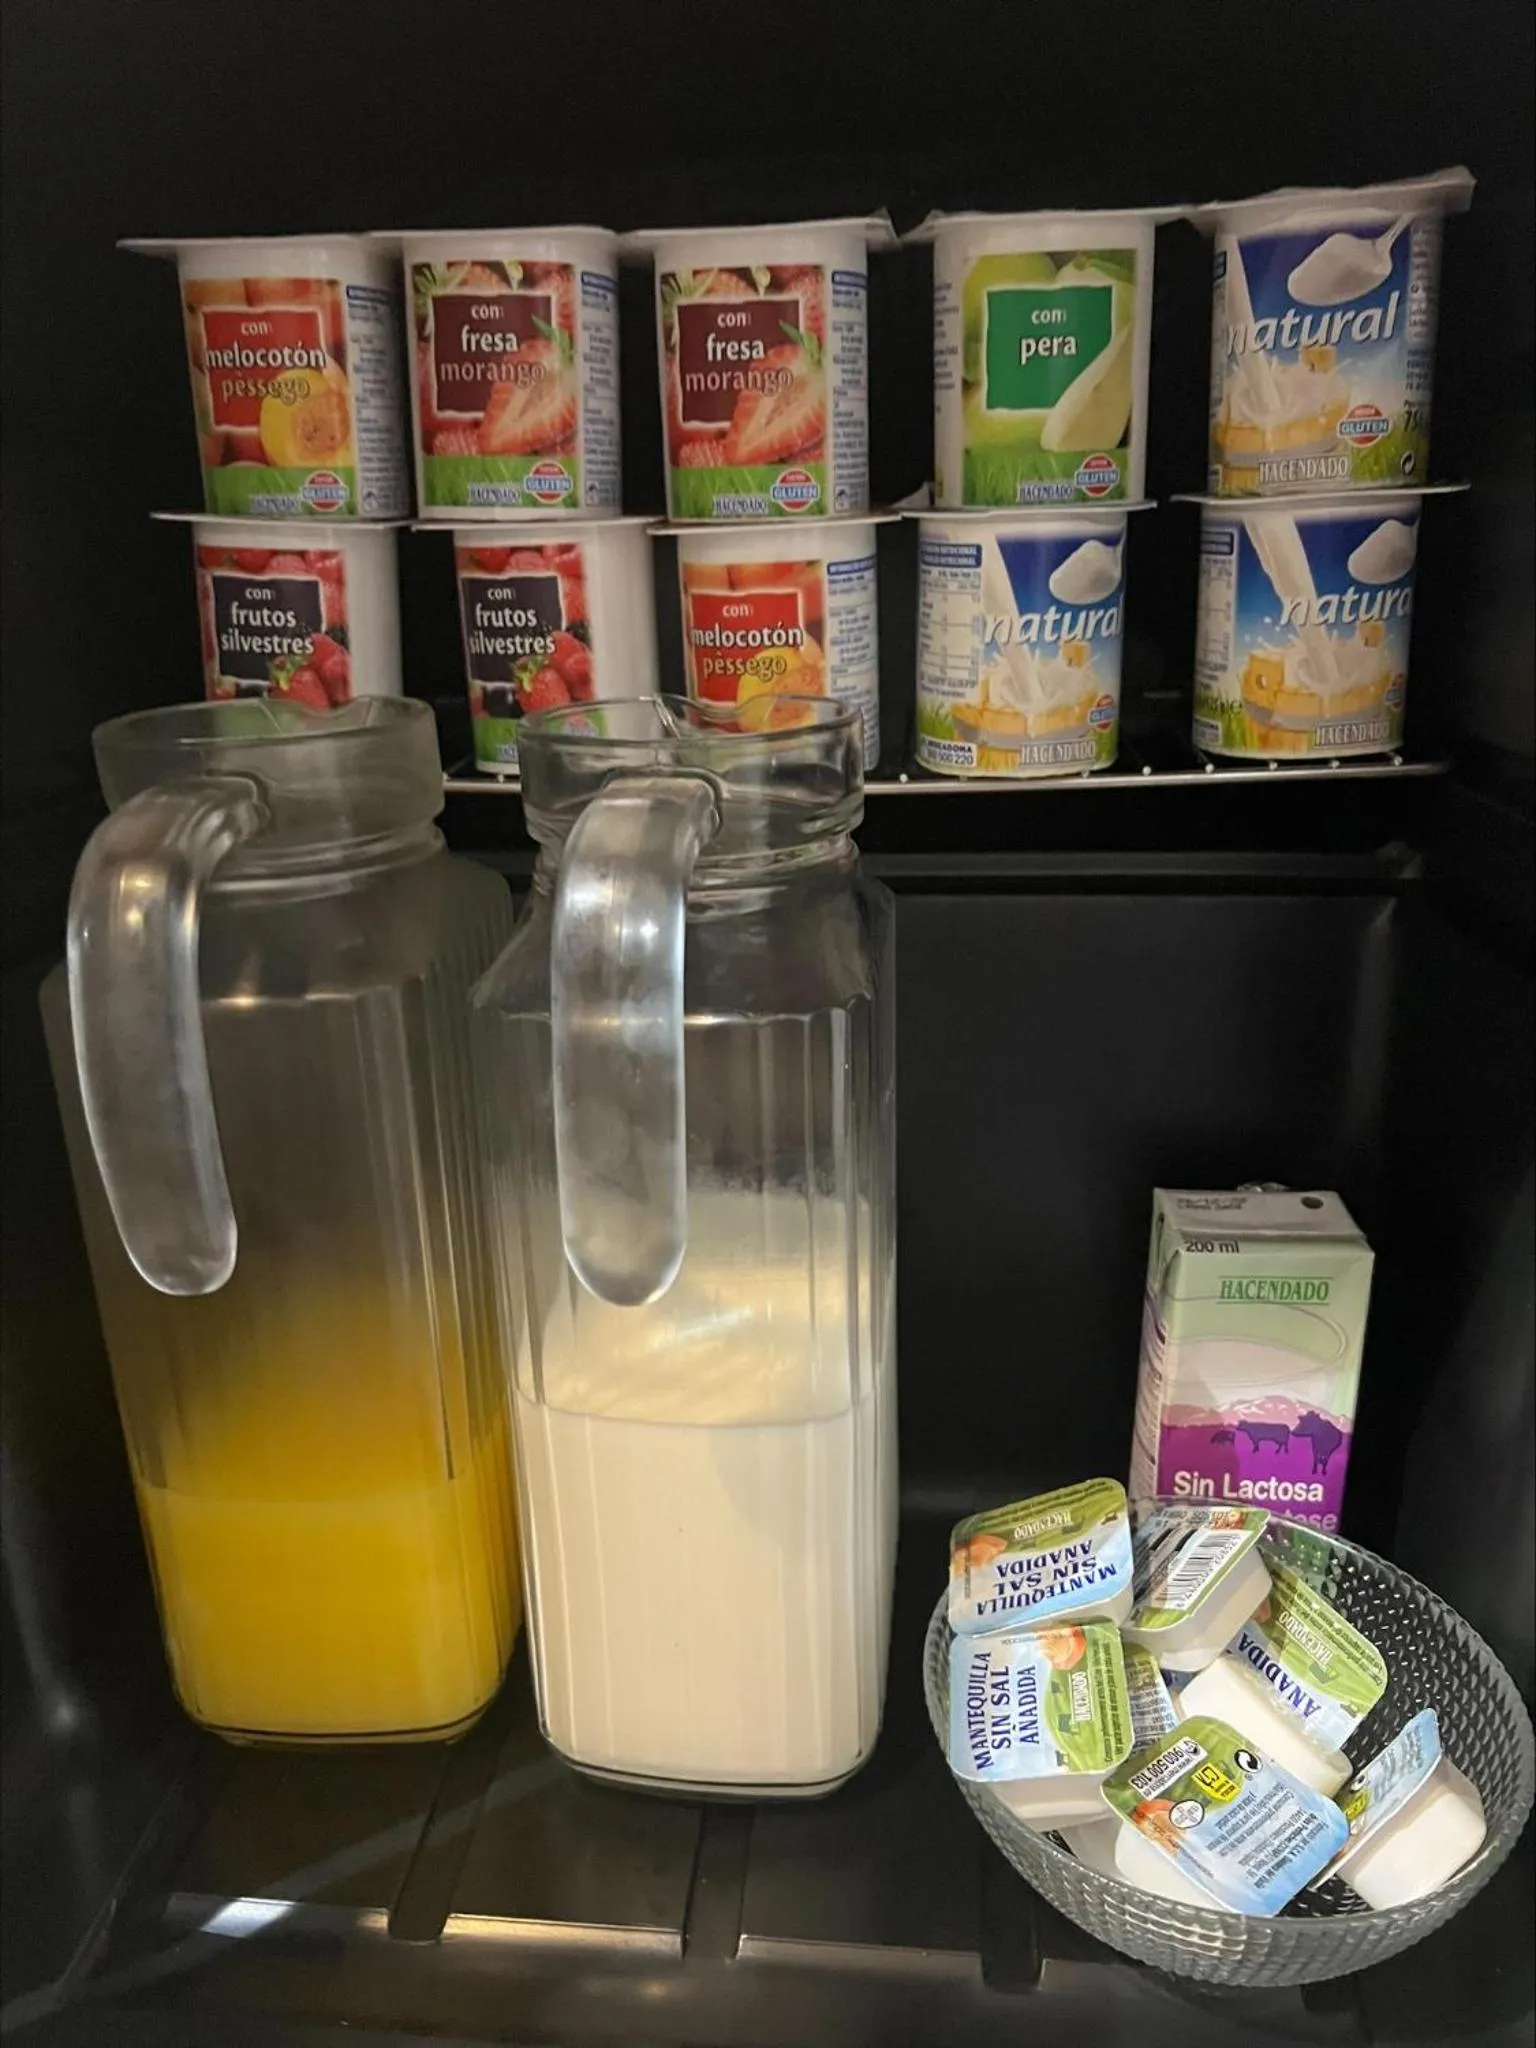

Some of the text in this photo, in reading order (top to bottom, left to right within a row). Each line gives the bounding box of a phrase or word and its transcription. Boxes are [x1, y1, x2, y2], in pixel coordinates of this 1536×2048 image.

[1226, 290, 1400, 355] natural
[461, 326, 518, 352] fresa
[707, 333, 765, 361] fresa
[1020, 335, 1077, 365] pera
[205, 341, 327, 368] melocotón
[440, 362, 546, 390] morango
[685, 368, 794, 397] morango
[1340, 420, 1388, 434] GLUTEN
[1259, 456, 1348, 483] HACENDADO
[772, 485, 818, 500] GLUTEN
[231, 601, 296, 627] frutos
[475, 603, 537, 628] frutos
[220, 628, 315, 655] silvestres
[469, 631, 556, 655] silvestres
[691, 621, 804, 648] melocotón
[1021, 741, 1096, 766] HACENDADO
[1186, 1240, 1240, 1254] 200 ml
[1219, 1279, 1330, 1301] HACENDADO
[1174, 1470, 1324, 1502] Sin Lactosa
[1014, 1510, 1074, 1540] HACENDADO
[996, 1540, 1093, 1578] AÑADIDA
[1053, 1557, 1098, 1582] SIN
[976, 1563, 1117, 1616] MANTEQUILLA
[993, 1571, 1042, 1596] SAL
[1278, 1610, 1335, 1668] HACENDADO
[991, 1665, 1012, 1750] SIN SAL
[1012, 1665, 1039, 1745] AÑADIDA
[1071, 1671, 1092, 1722] HACENDADO
[967, 1651, 994, 1771] MANTEQUILLA
[1131, 1747, 1185, 1789] 900 500 103
